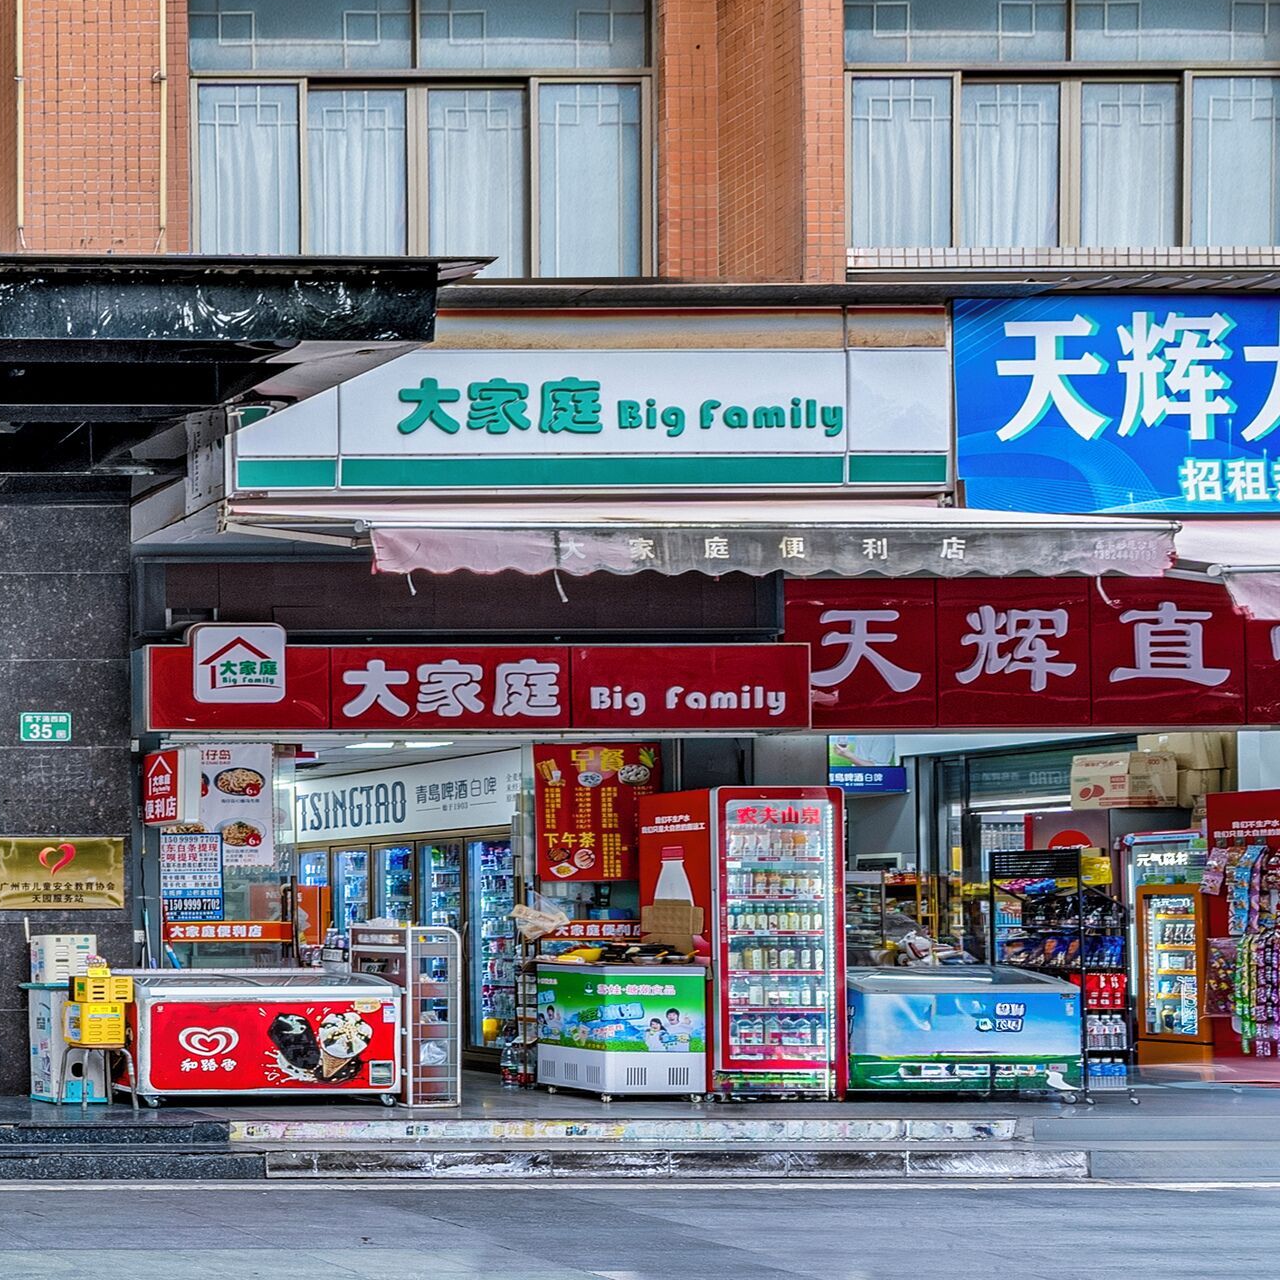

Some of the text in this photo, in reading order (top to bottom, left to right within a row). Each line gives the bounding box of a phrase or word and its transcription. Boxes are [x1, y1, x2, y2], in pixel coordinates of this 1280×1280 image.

[398, 377, 844, 437] 大家庭 Big Family
[1182, 459, 1280, 502] 招租
[561, 536, 967, 561] 大家庭便利店
[810, 601, 1280, 693] 天辉直
[220, 660, 278, 675] 大家庭
[222, 677, 238, 685] Big
[342, 658, 786, 718] 大家庭 Big Family
[29, 723, 53, 739] 35
[201, 749, 231, 761] 仔岛
[570, 748, 625, 772] 早餐
[144, 796, 177, 820] 便利店
[297, 780, 407, 832] TSINGTAO
[736, 805, 822, 825] 农夫山泉
[543, 832, 596, 848] 下午茶
[162, 844, 218, 853] 东白条提现
[162, 853, 198, 862] 呗提现
[0, 882, 116, 891] 广州市儿童安全教育协会
[169, 898, 220, 911] 150 9999 7702
[170, 925, 263, 938] 大家庭便利店
[180, 1058, 237, 1072] 和路雪
